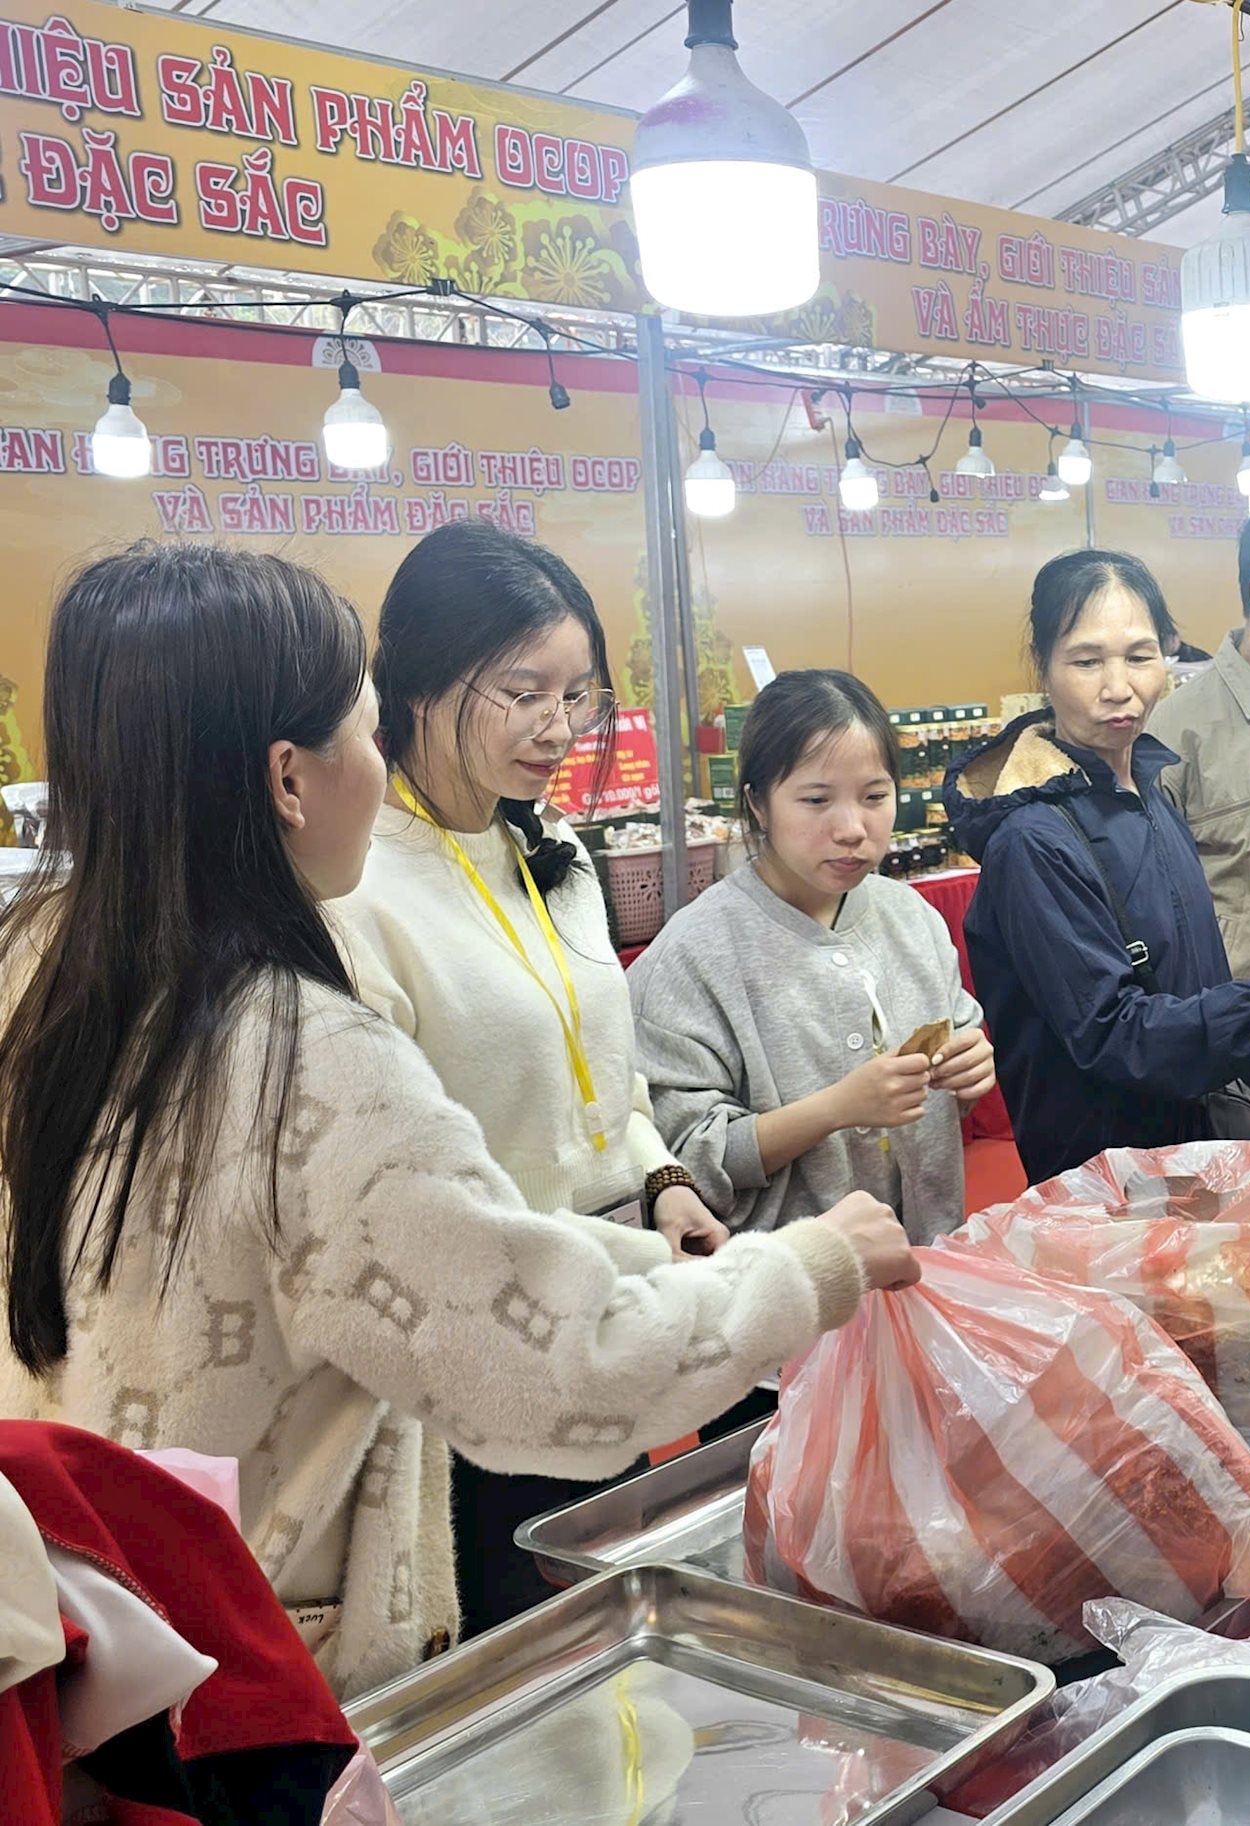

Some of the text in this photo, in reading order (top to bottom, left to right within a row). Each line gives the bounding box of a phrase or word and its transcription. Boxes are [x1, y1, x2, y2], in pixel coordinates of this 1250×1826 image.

[158, 46, 298, 146] SẢN
[310, 82, 482, 180] PHẨM
[494, 124, 629, 202] OCOP
[20, 129, 327, 246] ĐẶC SẮC
[819, 197, 910, 264] RƯNG
[918, 213, 990, 280] BÀY,
[999, 231, 1054, 288] GIỚI
[1061, 248, 1135, 307] THIỆU
[912, 280, 959, 340] VÀ
[966, 278, 1011, 347] ẨM
[1016, 304, 1089, 364] THỰC
[1095, 312, 1145, 371] ĐẶC
[0, 427, 65, 473] AN
[72, 431, 190, 476] HG
[195, 434, 319, 483] TRƯNG
[411, 442, 476, 487] GIỚI
[479, 447, 566, 495] THIỆU
[570, 454, 642, 491] OCOP
[153, 484, 213, 533] VÀ
[220, 482, 296, 534] SẢN
[302, 483, 400, 534] PHẨM
[800, 500, 832, 536] VÀ
[880, 496, 930, 537] PHẨM
[935, 502, 972, 542] ĐẶC
[975, 500, 1010, 537] SẮC
